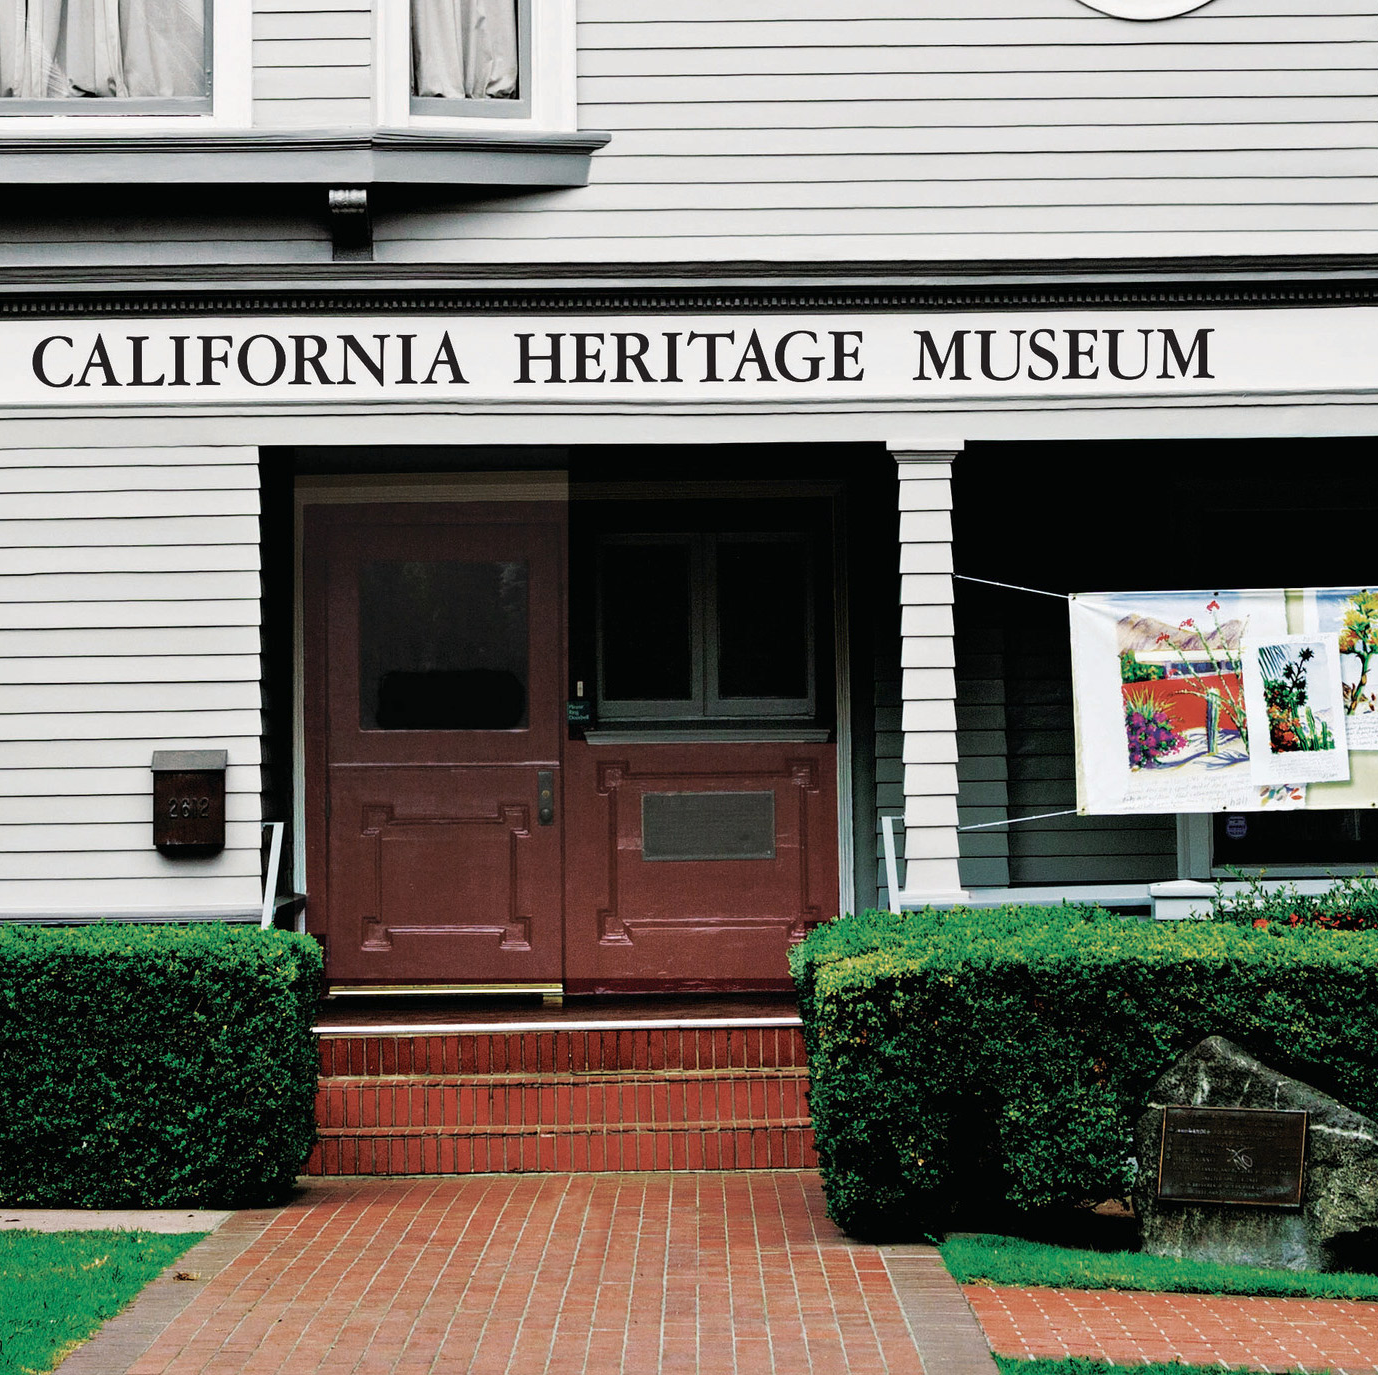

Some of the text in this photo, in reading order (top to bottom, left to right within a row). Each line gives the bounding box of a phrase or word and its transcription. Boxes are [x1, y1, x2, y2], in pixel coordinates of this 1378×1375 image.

[31, 327, 1216, 388] CALIFORNIA HERITAGE MUSEUM
[168, 796, 210, 819] 2612
